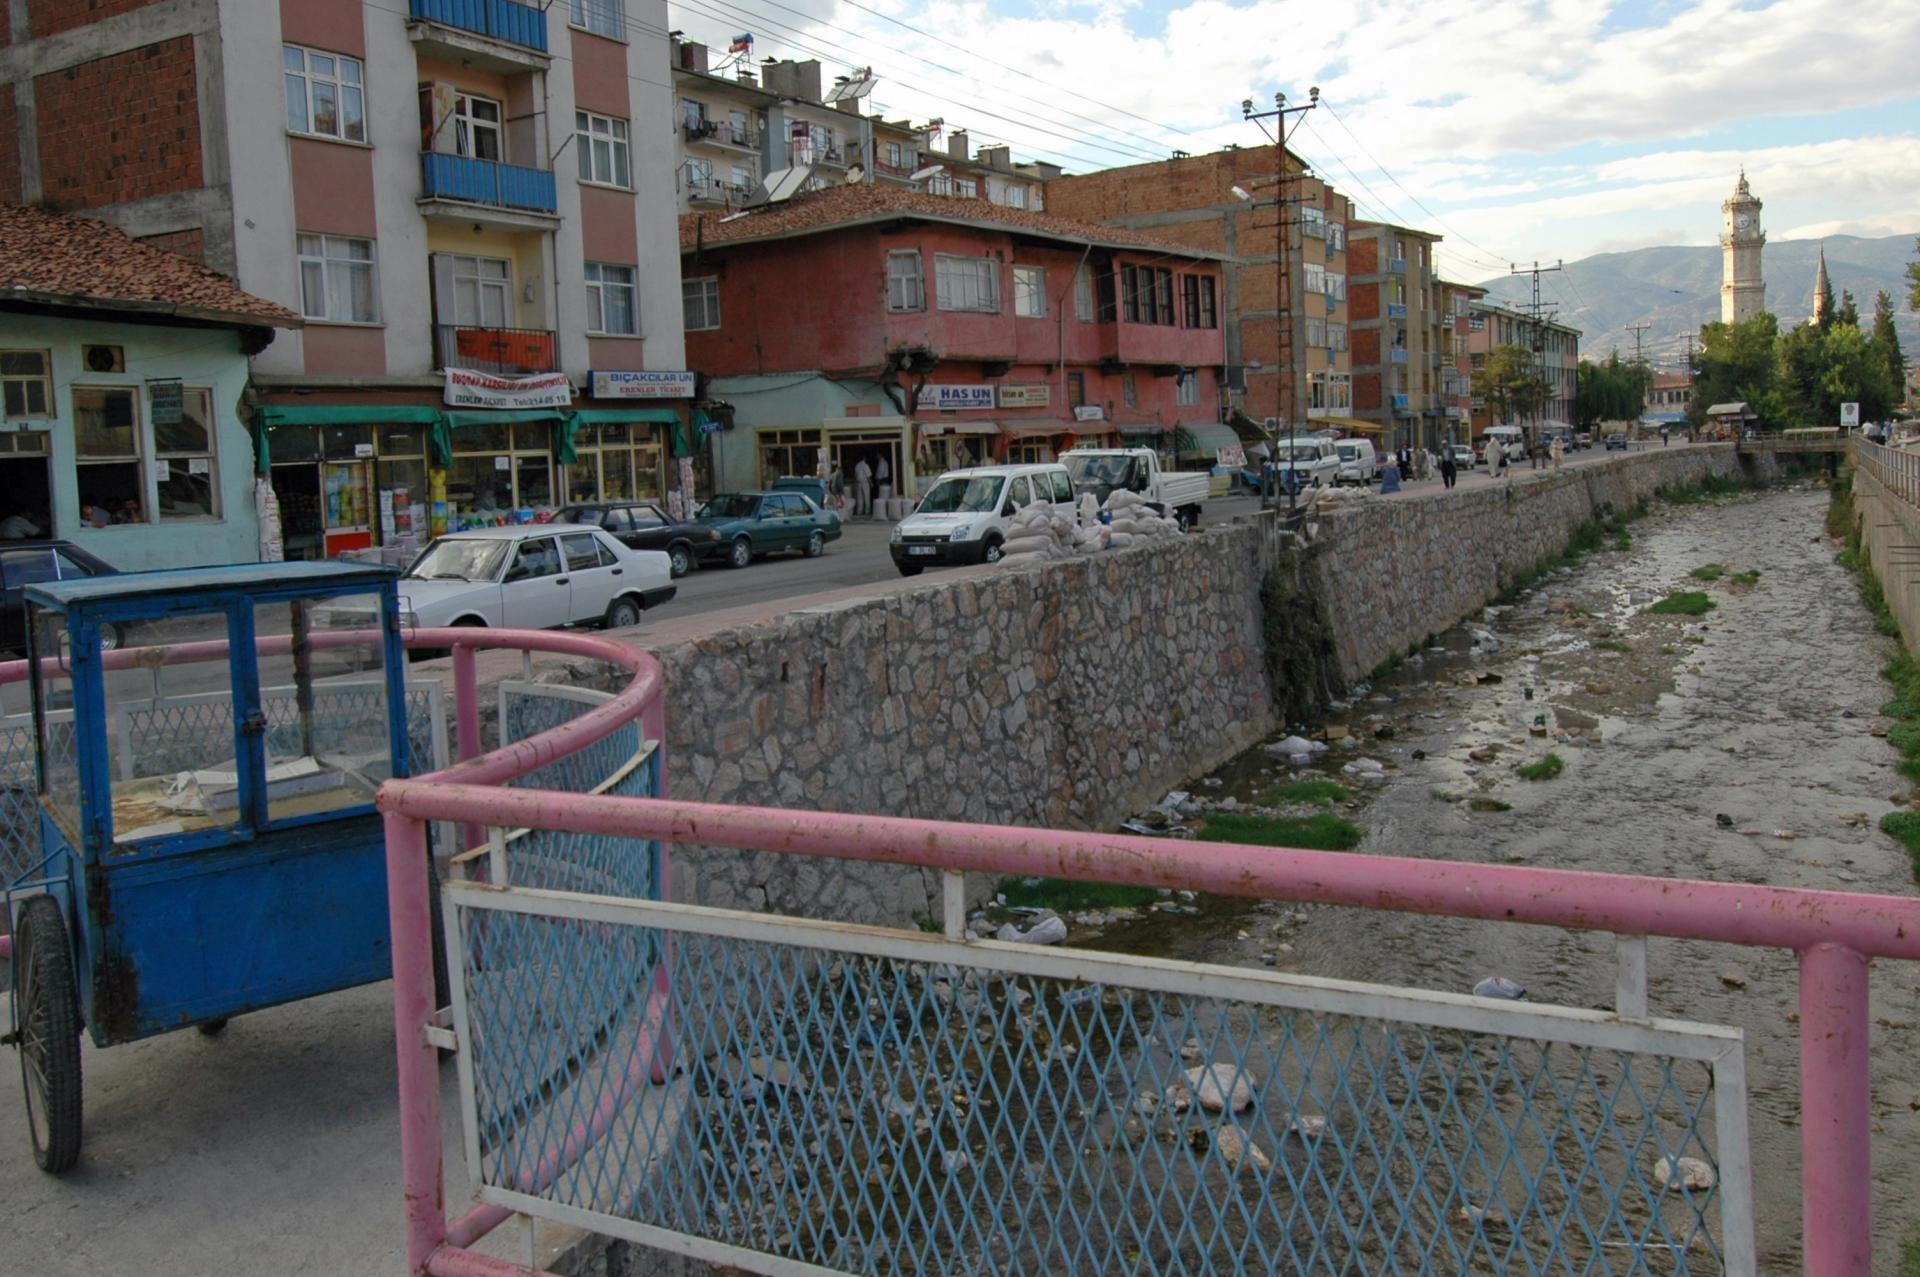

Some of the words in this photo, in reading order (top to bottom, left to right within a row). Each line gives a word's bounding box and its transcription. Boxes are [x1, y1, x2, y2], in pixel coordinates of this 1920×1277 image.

[679, 374, 693, 382] UN
[941, 388, 969, 399] HAS
[972, 388, 991, 399] UN
